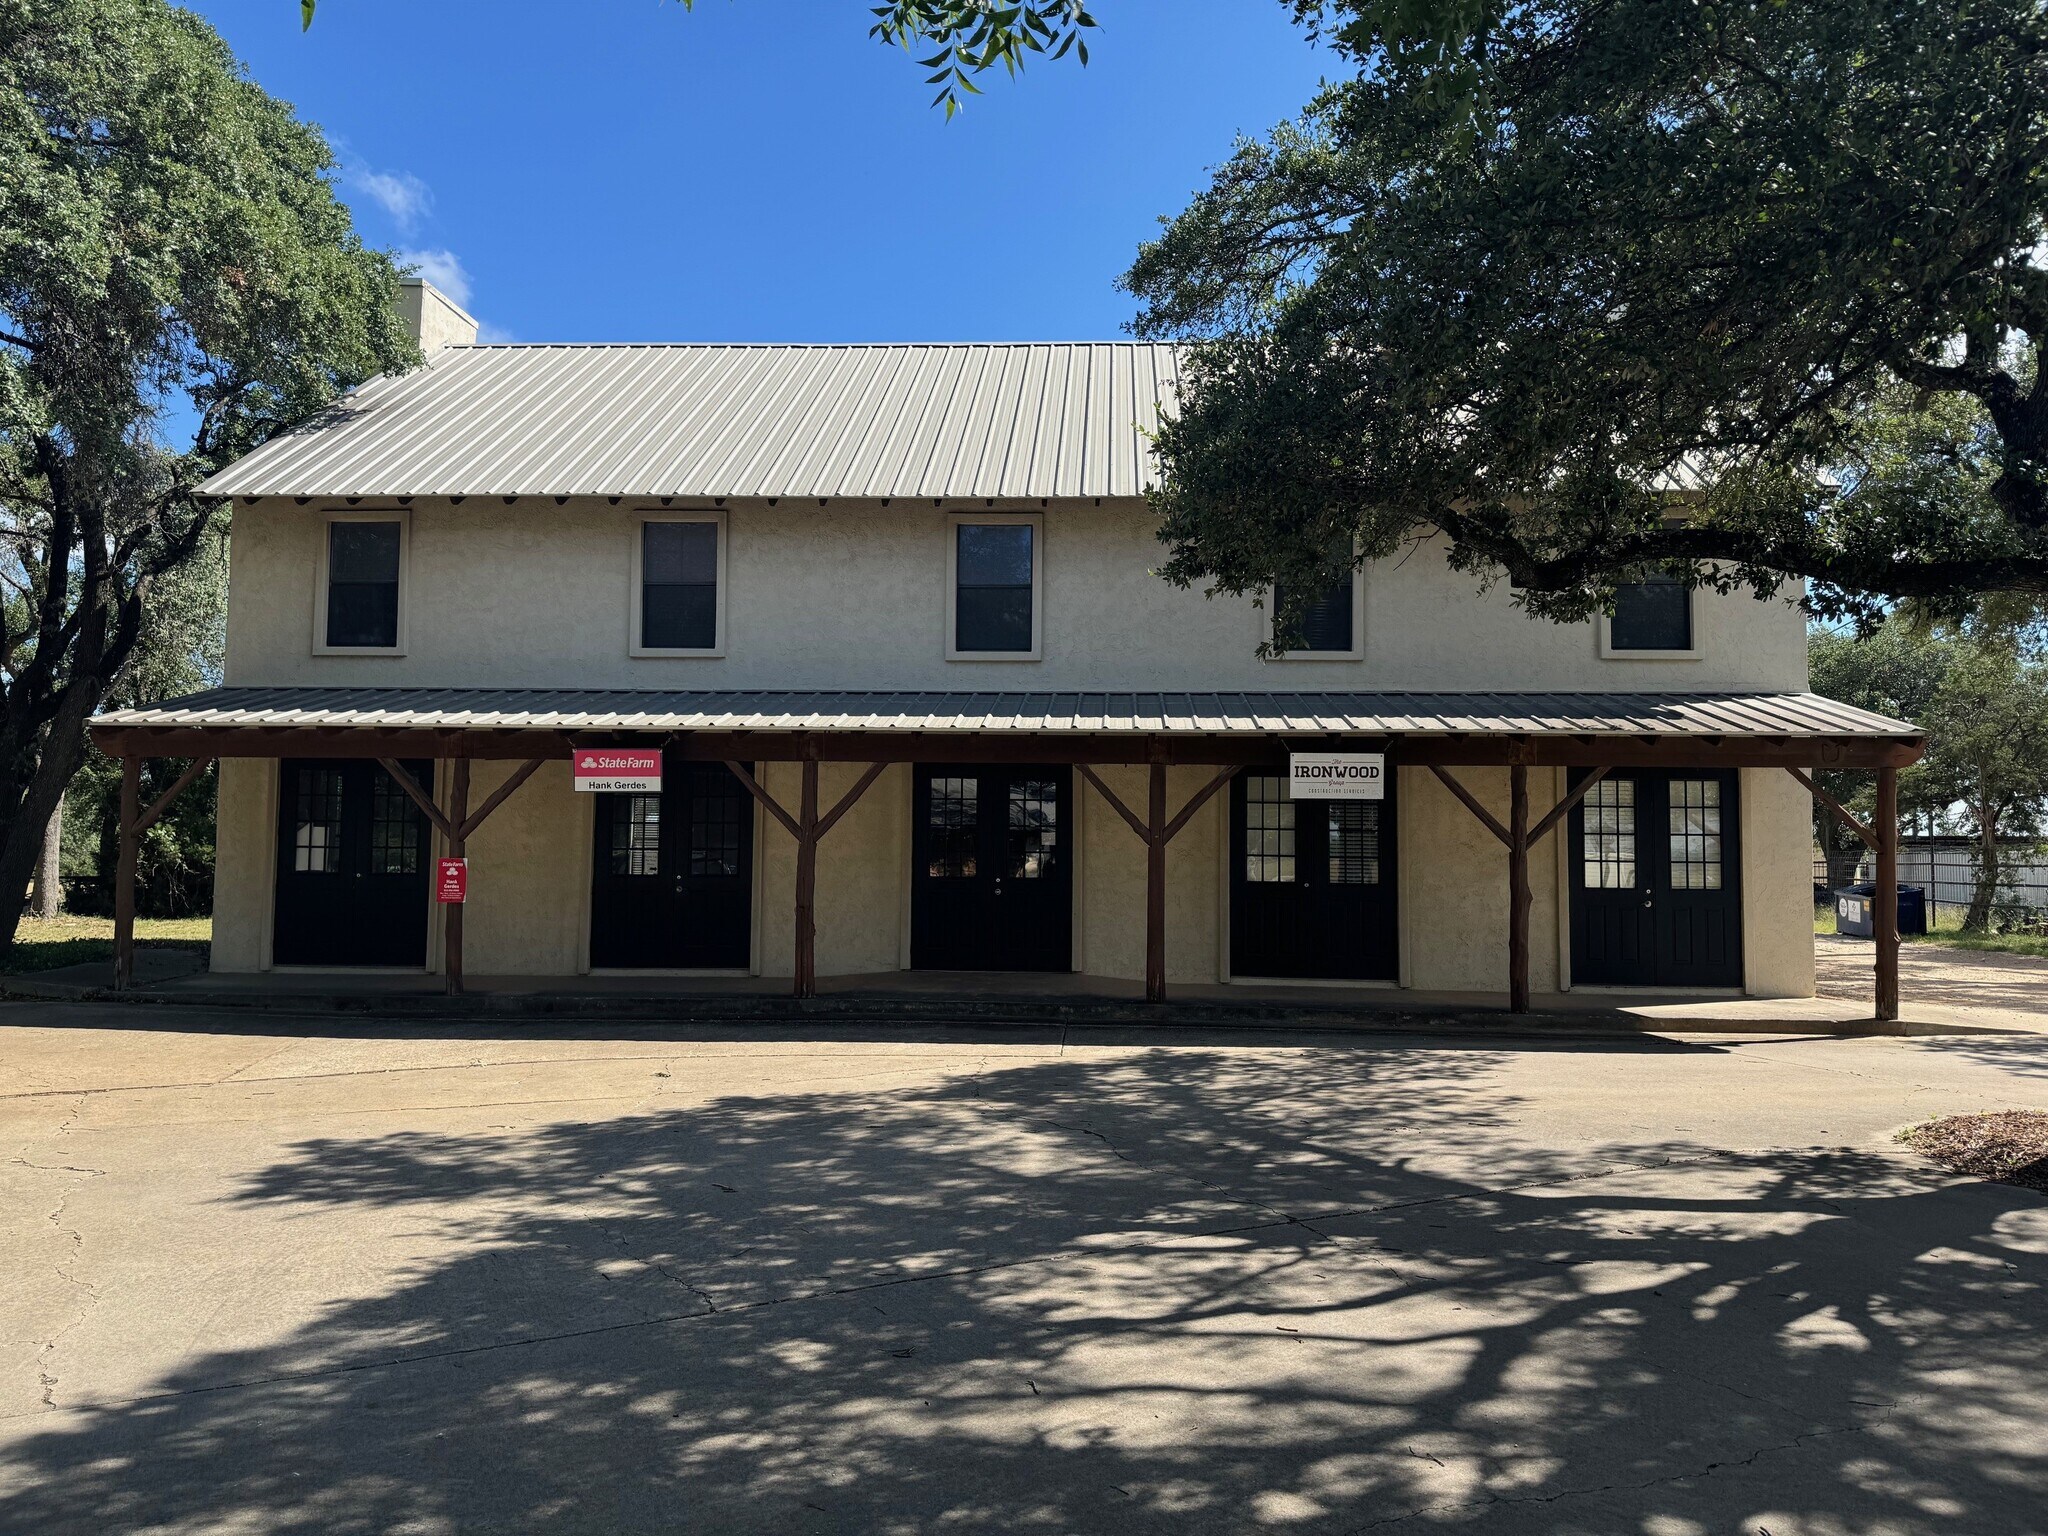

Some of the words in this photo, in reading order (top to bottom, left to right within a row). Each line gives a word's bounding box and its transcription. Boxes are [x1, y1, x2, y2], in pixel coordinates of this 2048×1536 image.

[1294, 765, 1380, 779] IRONWOOD
[588, 781, 612, 790] Hank
[614, 781, 647, 790] Gerdes
